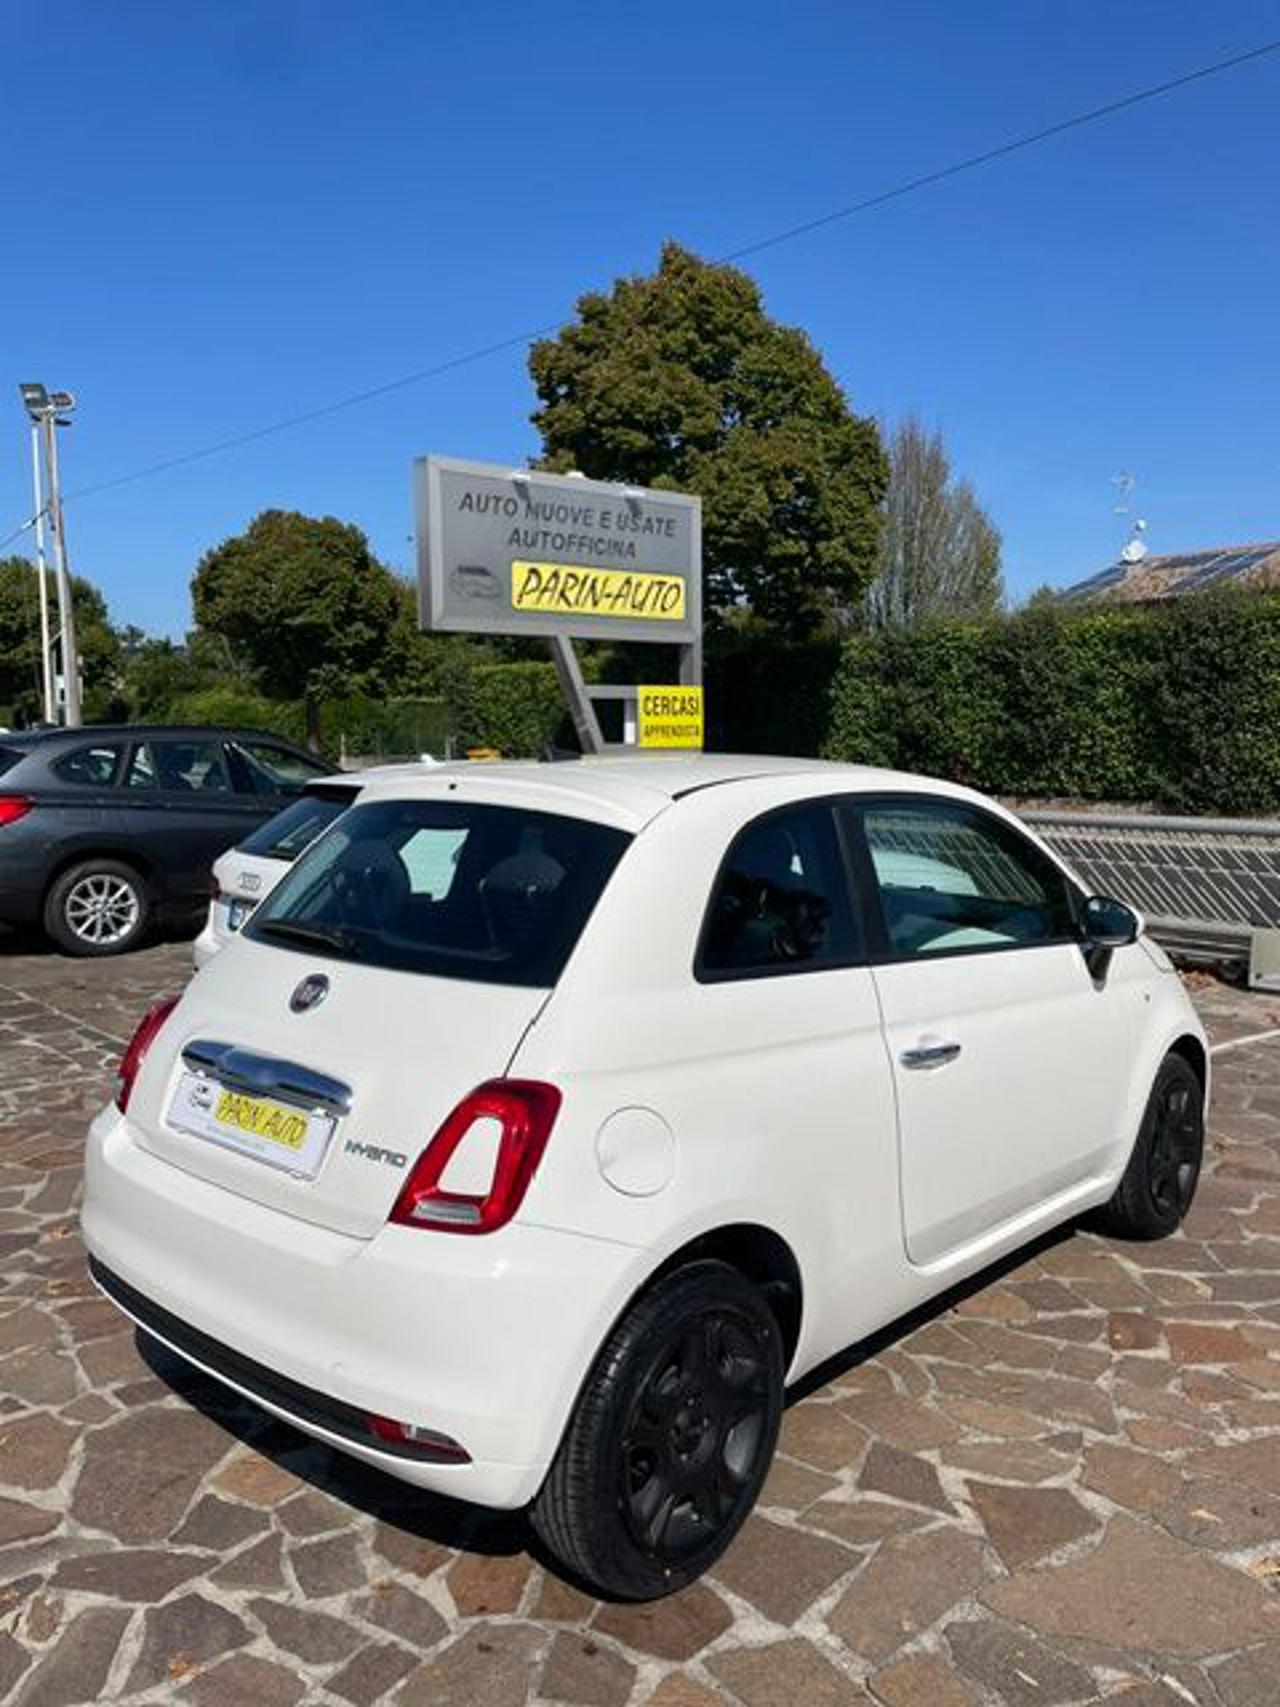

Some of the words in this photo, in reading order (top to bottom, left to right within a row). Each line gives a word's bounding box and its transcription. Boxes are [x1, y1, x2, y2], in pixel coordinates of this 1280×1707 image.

[459, 492, 518, 516] AUTO
[525, 501, 593, 527] NUOVE
[600, 511, 612, 530] E
[617, 511, 676, 537] USATE
[509, 528, 636, 558] AUTOFFICINA
[518, 567, 681, 612] PARIN-AUTO
[643, 695, 699, 716] CERCASI
